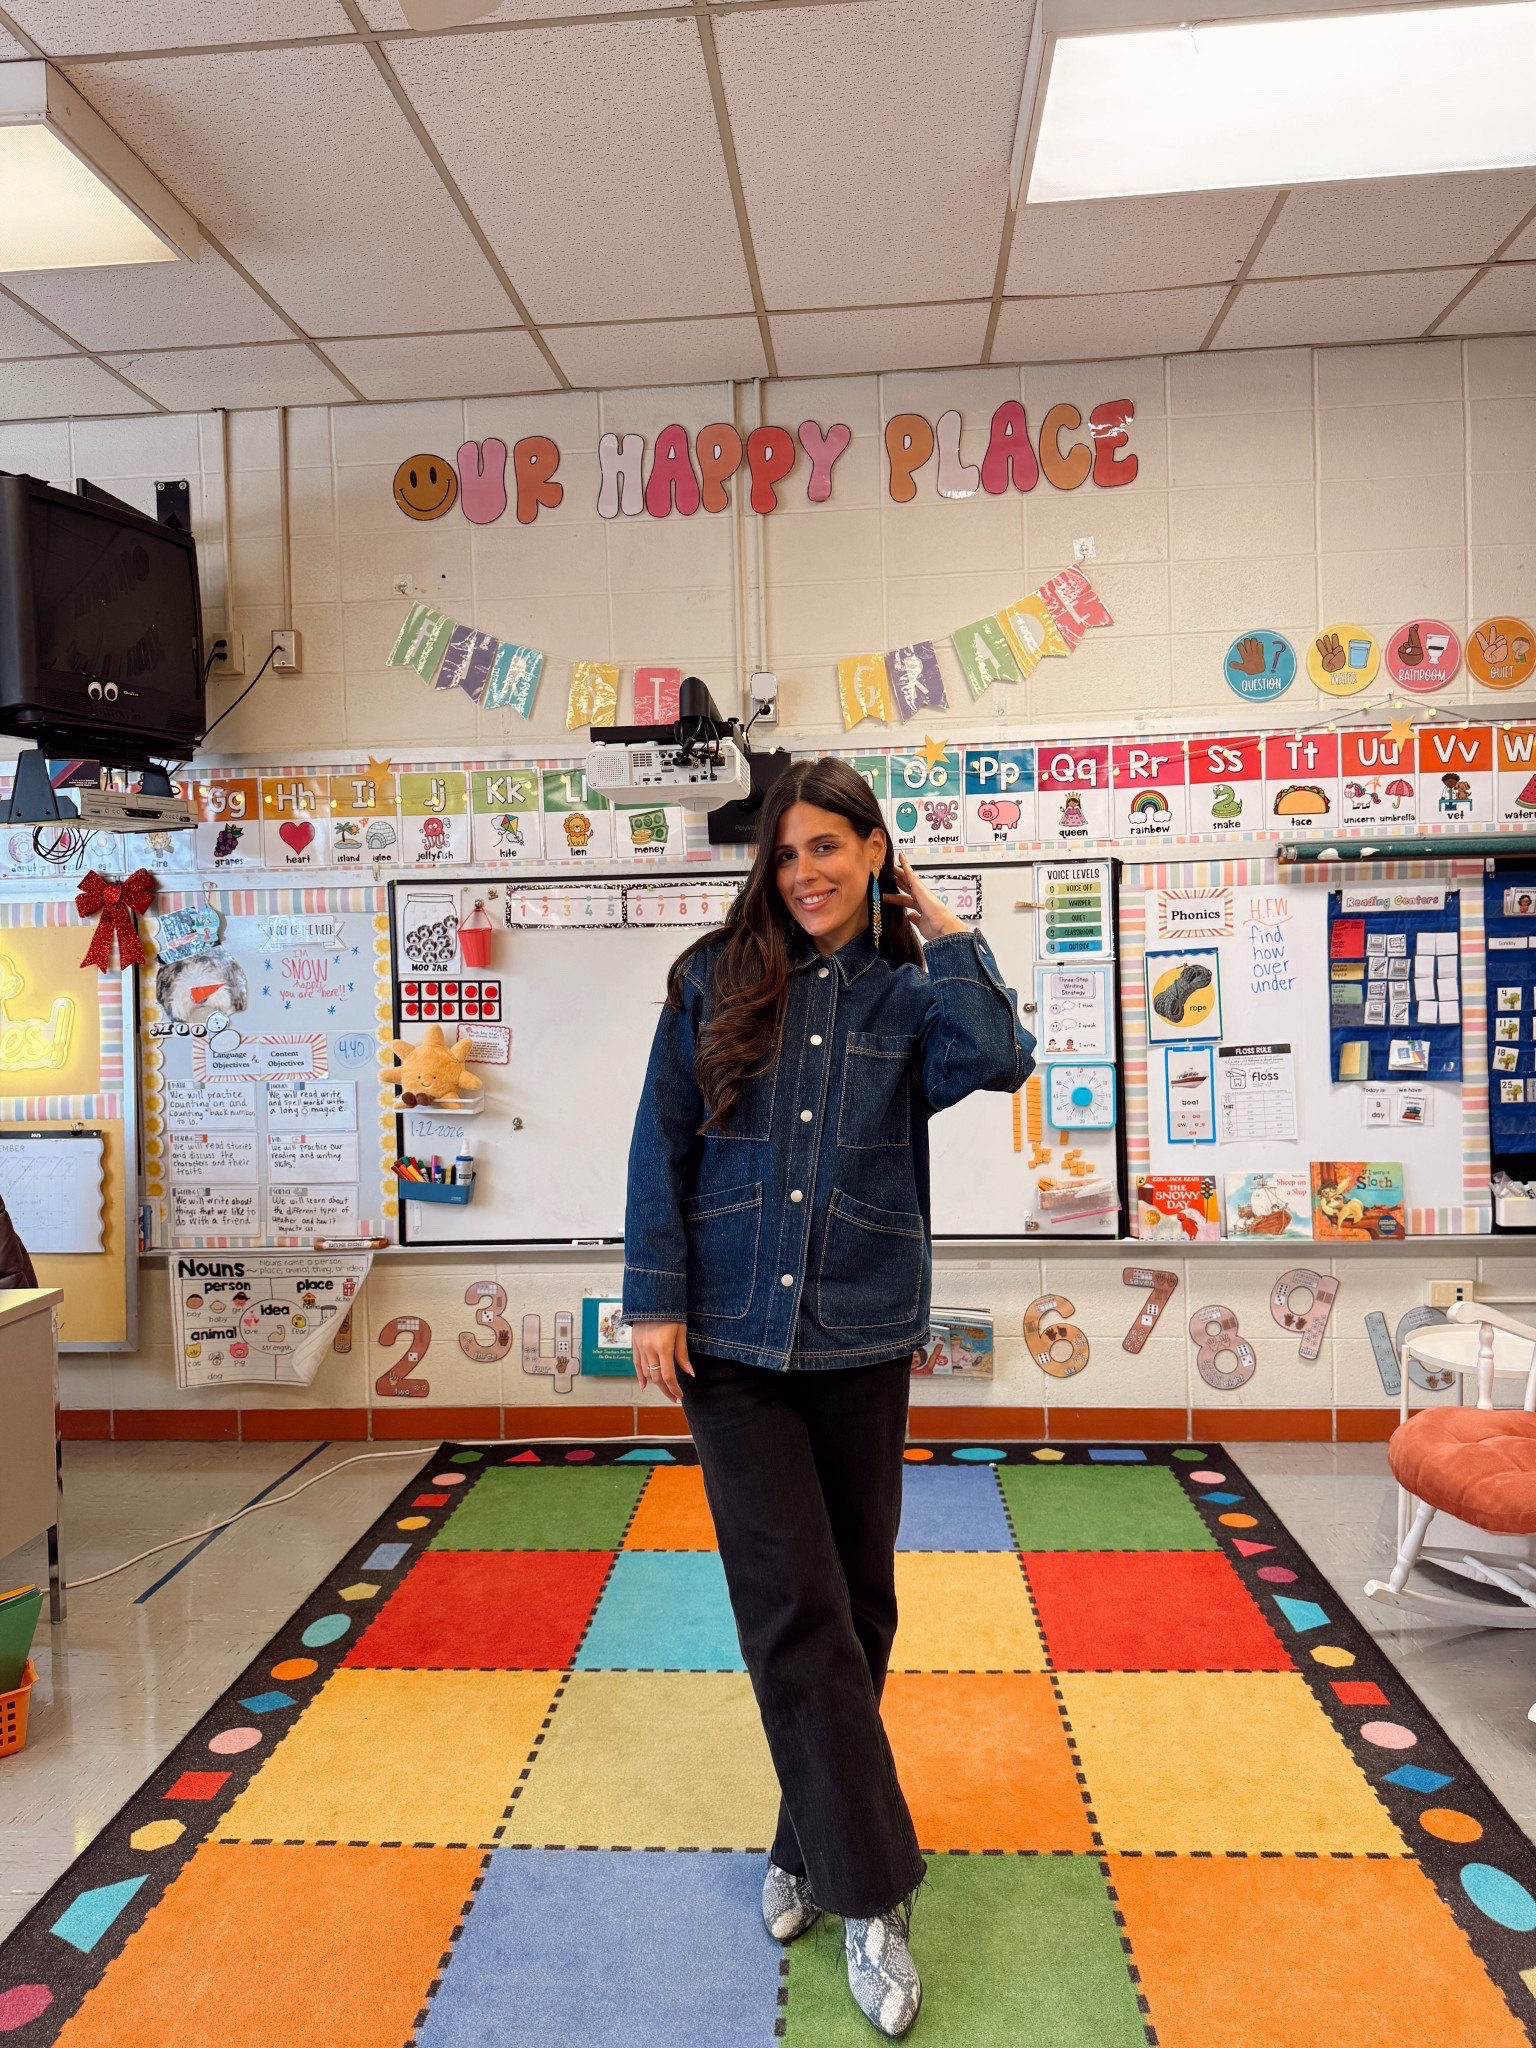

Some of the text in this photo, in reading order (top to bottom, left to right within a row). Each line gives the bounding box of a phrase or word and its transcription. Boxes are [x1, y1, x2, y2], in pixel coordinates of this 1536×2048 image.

[597, 420, 851, 519] HAPPY
[885, 399, 1139, 503] PLACE
[1398, 667, 1447, 682] BATHROOM
[1489, 664, 1515, 680] QUIET
[1330, 671, 1358, 686] WATER
[1241, 678, 1283, 692] QUESTION
[1357, 737, 1401, 767] Uu
[1432, 734, 1480, 764] Vv
[1207, 744, 1245, 774] Ss
[1284, 740, 1320, 771] Tt
[1050, 753, 1098, 787] Qq
[1129, 749, 1169, 780] Rr
[902, 759, 950, 790] Oo
[978, 756, 1021, 792] Pp
[351, 780, 377, 809] Ii
[486, 775, 527, 806] Kk
[565, 774, 588, 804] Ll
[277, 783, 317, 812] Hh
[423, 778, 447, 813] Jj
[206, 785, 247, 819] Gg
[1344, 812, 1416, 825] unicorn umbrella
[1447, 810, 1465, 820] vet
[1213, 819, 1241, 830] snake
[1291, 816, 1313, 827] taco
[994, 830, 1008, 841] pig
[1058, 827, 1089, 838] queen
[1130, 824, 1171, 835] rainbow
[898, 835, 916, 845] oval
[928, 834, 959, 845] octopus
[415, 849, 454, 862] jellyfish
[499, 847, 518, 858] kite
[570, 847, 588, 857] lion
[634, 844, 666, 855] money
[214, 858, 245, 869] grapes
[286, 855, 311, 864] heart
[337, 854, 361, 863] island
[372, 853, 392, 863] igloo
[1047, 868, 1100, 880] VOICE LEVELS
[1066, 884, 1082, 892] VOICE
[1083, 883, 1093, 891] OFF
[700, 901, 709, 914] 9
[957, 894, 973, 909] 20
[1050, 899, 1091, 908] 1 WHISPER
[1346, 895, 1439, 909] Reading Centers
[519, 904, 527, 917] 1
[541, 904, 550, 917] 2
[563, 904, 572, 916] 3
[584, 904, 593, 916] 4
[607, 903, 616, 916] 5
[634, 904, 644, 917] 6
[657, 903, 665, 916] 7
[679, 902, 688, 916] 8
[1171, 909, 1221, 921] Phonics
[1050, 914, 1086, 922] 2 QUIET
[1050, 928, 1094, 937] 3 CLASSROOM
[1249, 925, 1284, 944] find
[1050, 942, 1090, 951] 4 OUTSIDE
[1498, 939, 1516, 947] Sunday
[1253, 945, 1285, 960] how
[281, 957, 328, 982] SNOW
[411, 963, 448, 972] MOO JAR
[1253, 960, 1290, 978] over
[1058, 977, 1089, 985] Three-Step
[1063, 983, 1084, 991] Writing
[1251, 976, 1297, 993] under
[293, 979, 327, 997] happy
[1061, 989, 1086, 997] Strategy
[1501, 989, 1508, 997] 4
[280, 990, 296, 1000] you
[298, 989, 314, 999] are
[1189, 1004, 1207, 1013] rope
[1499, 1019, 1507, 1027] 11
[150, 1022, 208, 1038] MOO
[212, 1051, 247, 1060] Language
[270, 1050, 299, 1058] Content
[1235, 1046, 1272, 1055] FLOSS RULE
[1497, 1048, 1506, 1056] 18
[212, 1061, 251, 1070] Objectives
[268, 1059, 305, 1068] Objectives
[1252, 1072, 1279, 1082] floss
[1502, 1080, 1513, 1089] 25
[187, 1089, 243, 1101] will practice
[280, 1106, 299, 1117] long
[410, 1121, 464, 1138] 1-22-2026
[271, 1152, 296, 1162] reading
[317, 1151, 342, 1162] writing
[1167, 1184, 1187, 1192] THE
[1276, 1178, 1297, 1187] Sheep
[1356, 1175, 1393, 1190] Sloth
[1155, 1191, 1200, 1200] SNOWY
[1292, 1187, 1307, 1198] Ship
[272, 1196, 286, 1204] We
[290, 1196, 304, 1204] will
[329, 1195, 349, 1205] about
[1166, 1199, 1190, 1209] DAY
[287, 1206, 317, 1215] different
[178, 1259, 245, 1278] Nouns
[204, 1281, 251, 1293] person
[297, 1279, 334, 1293] place
[1129, 1278, 1155, 1287] seven
[186, 1311, 202, 1319] boy
[260, 1304, 290, 1315] idea
[1122, 1267, 1179, 1354] 7
[1269, 1268, 1340, 1361] 9
[458, 1281, 514, 1363] 3
[191, 1327, 237, 1341] animal
[1023, 1293, 1090, 1378] 6
[521, 1311, 581, 1394] 4
[1189, 1305, 1257, 1391] 8
[1300, 1346, 1318, 1357] nine
[375, 1315, 432, 1398] 2
[473, 1352, 498, 1360] three
[531, 1365, 551, 1374] four
[1063, 1367, 1077, 1376] six
[207, 1373, 223, 1381] dog
[1223, 1373, 1245, 1388] eight
[394, 1388, 410, 1396] two
